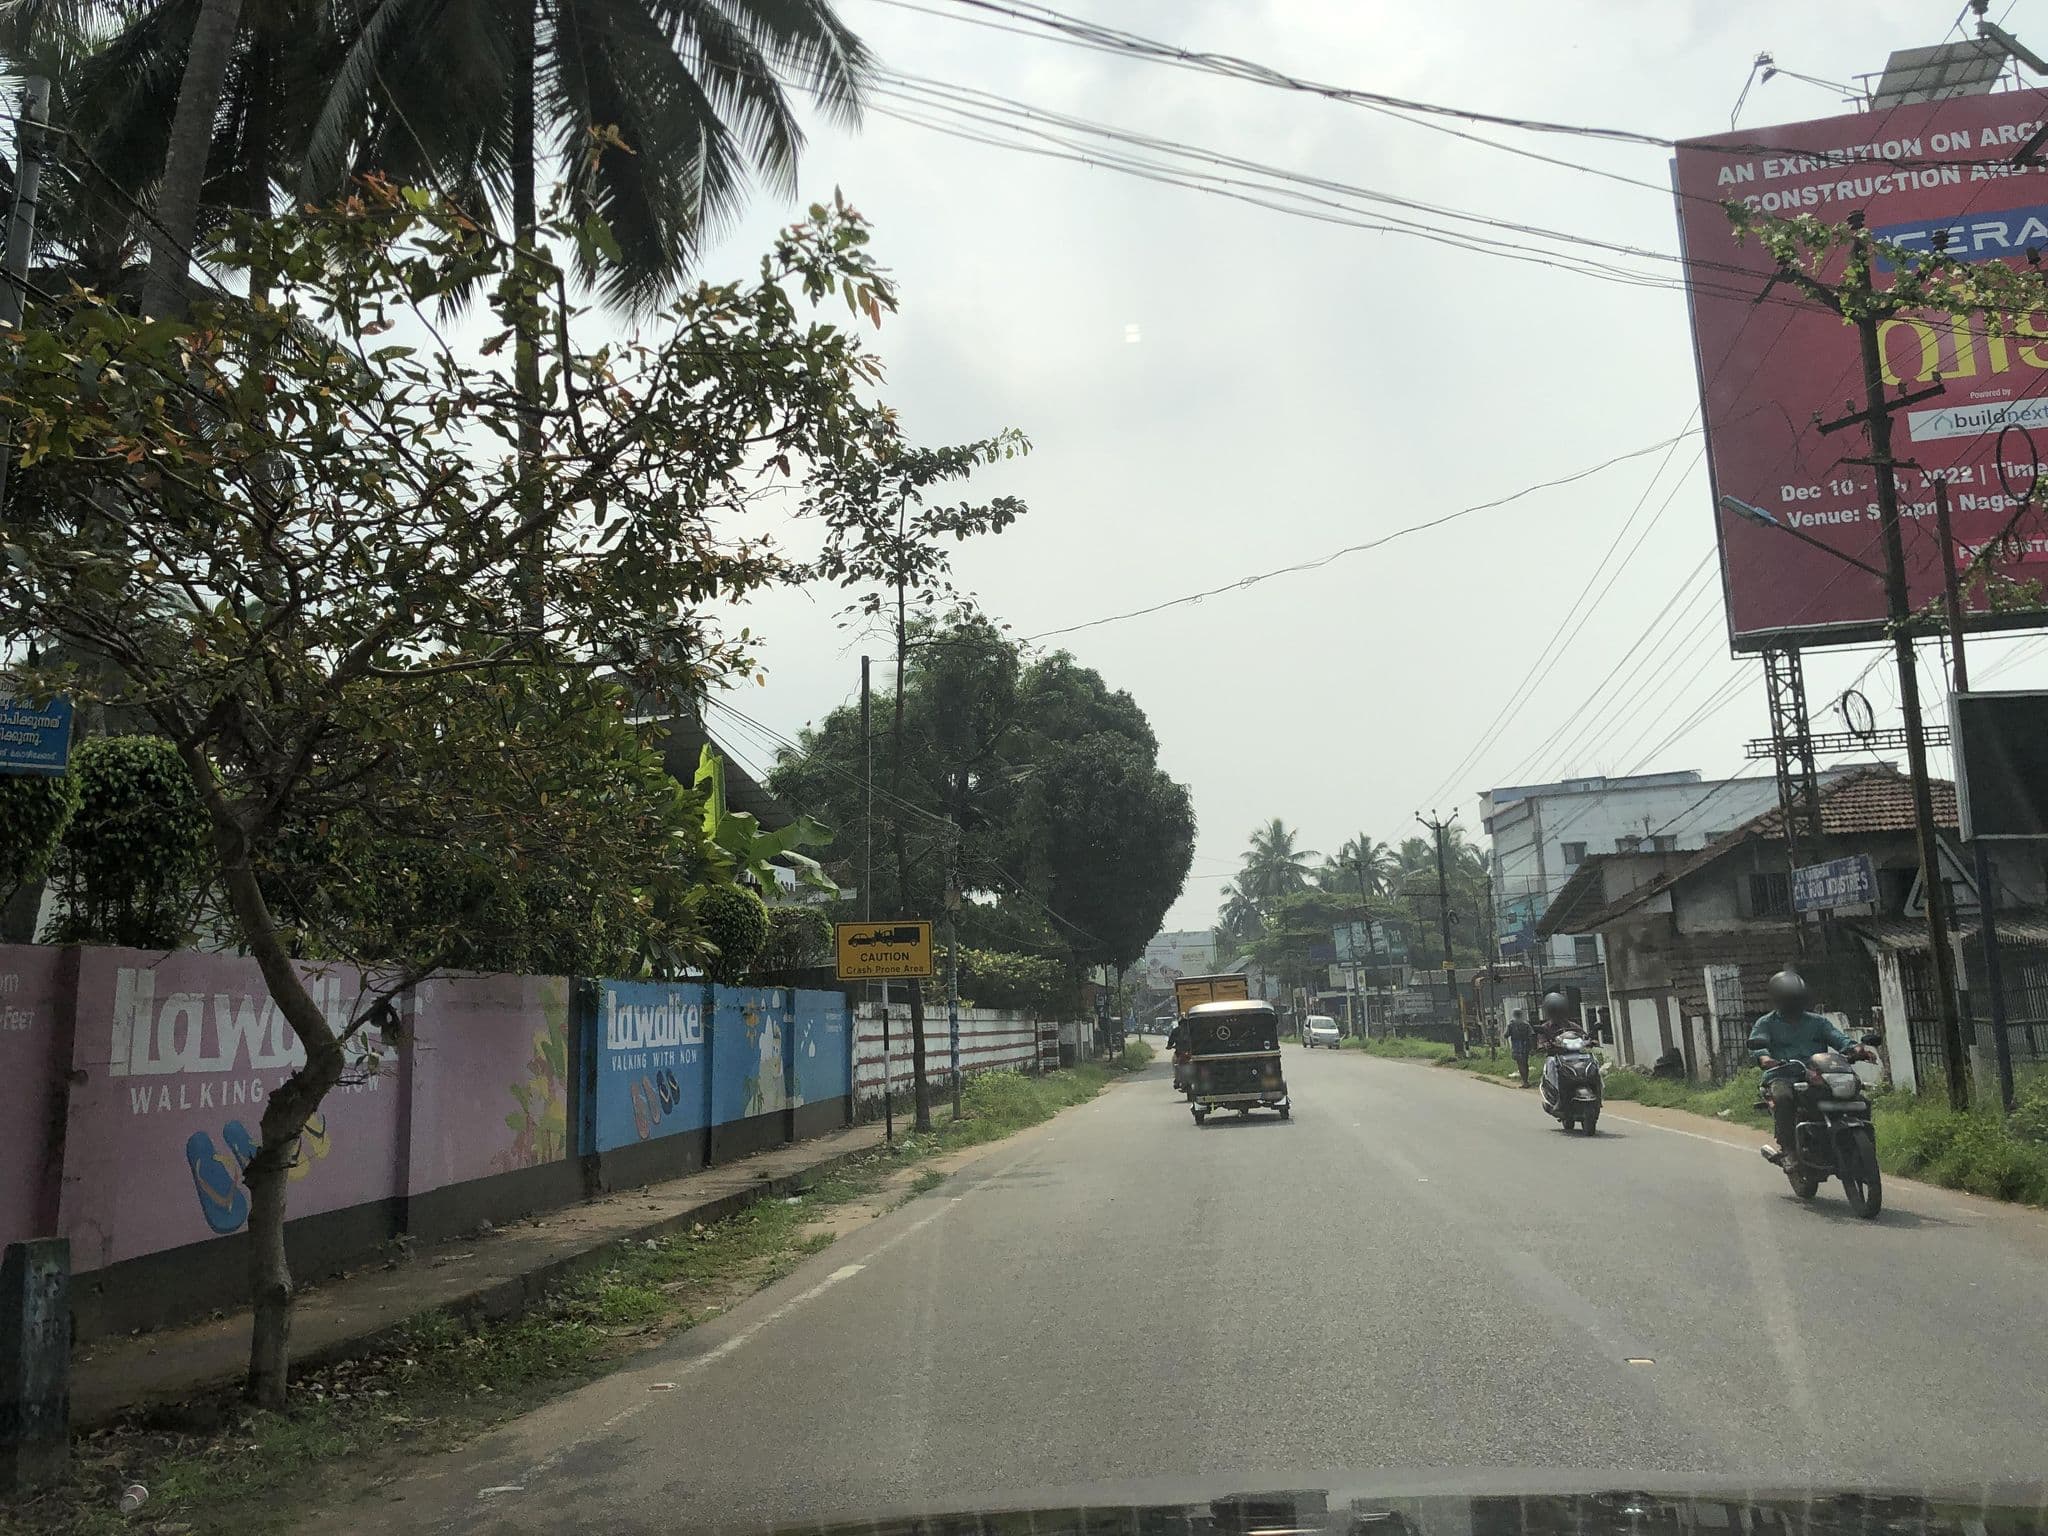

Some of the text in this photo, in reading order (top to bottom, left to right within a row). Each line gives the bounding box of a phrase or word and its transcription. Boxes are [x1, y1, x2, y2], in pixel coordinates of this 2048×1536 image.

[1717, 162, 1755, 186] AN
[1763, 137, 1923, 179] EXHIBITION
[1931, 130, 1971, 153] ON
[1743, 164, 1962, 213] CONSTRUCTION
[1970, 387, 2012, 400] Powered by
[1780, 484, 1822, 502] Dec
[1829, 479, 1854, 496] 10
[1786, 488, 2030, 528] Venue: Sapn Nagar
[860, 952, 910, 962] CAUTION
[846, 964, 924, 975] Crash Prone Area
[653, 1050, 675, 1067] WITH
[130, 1077, 264, 1115] WALKING
